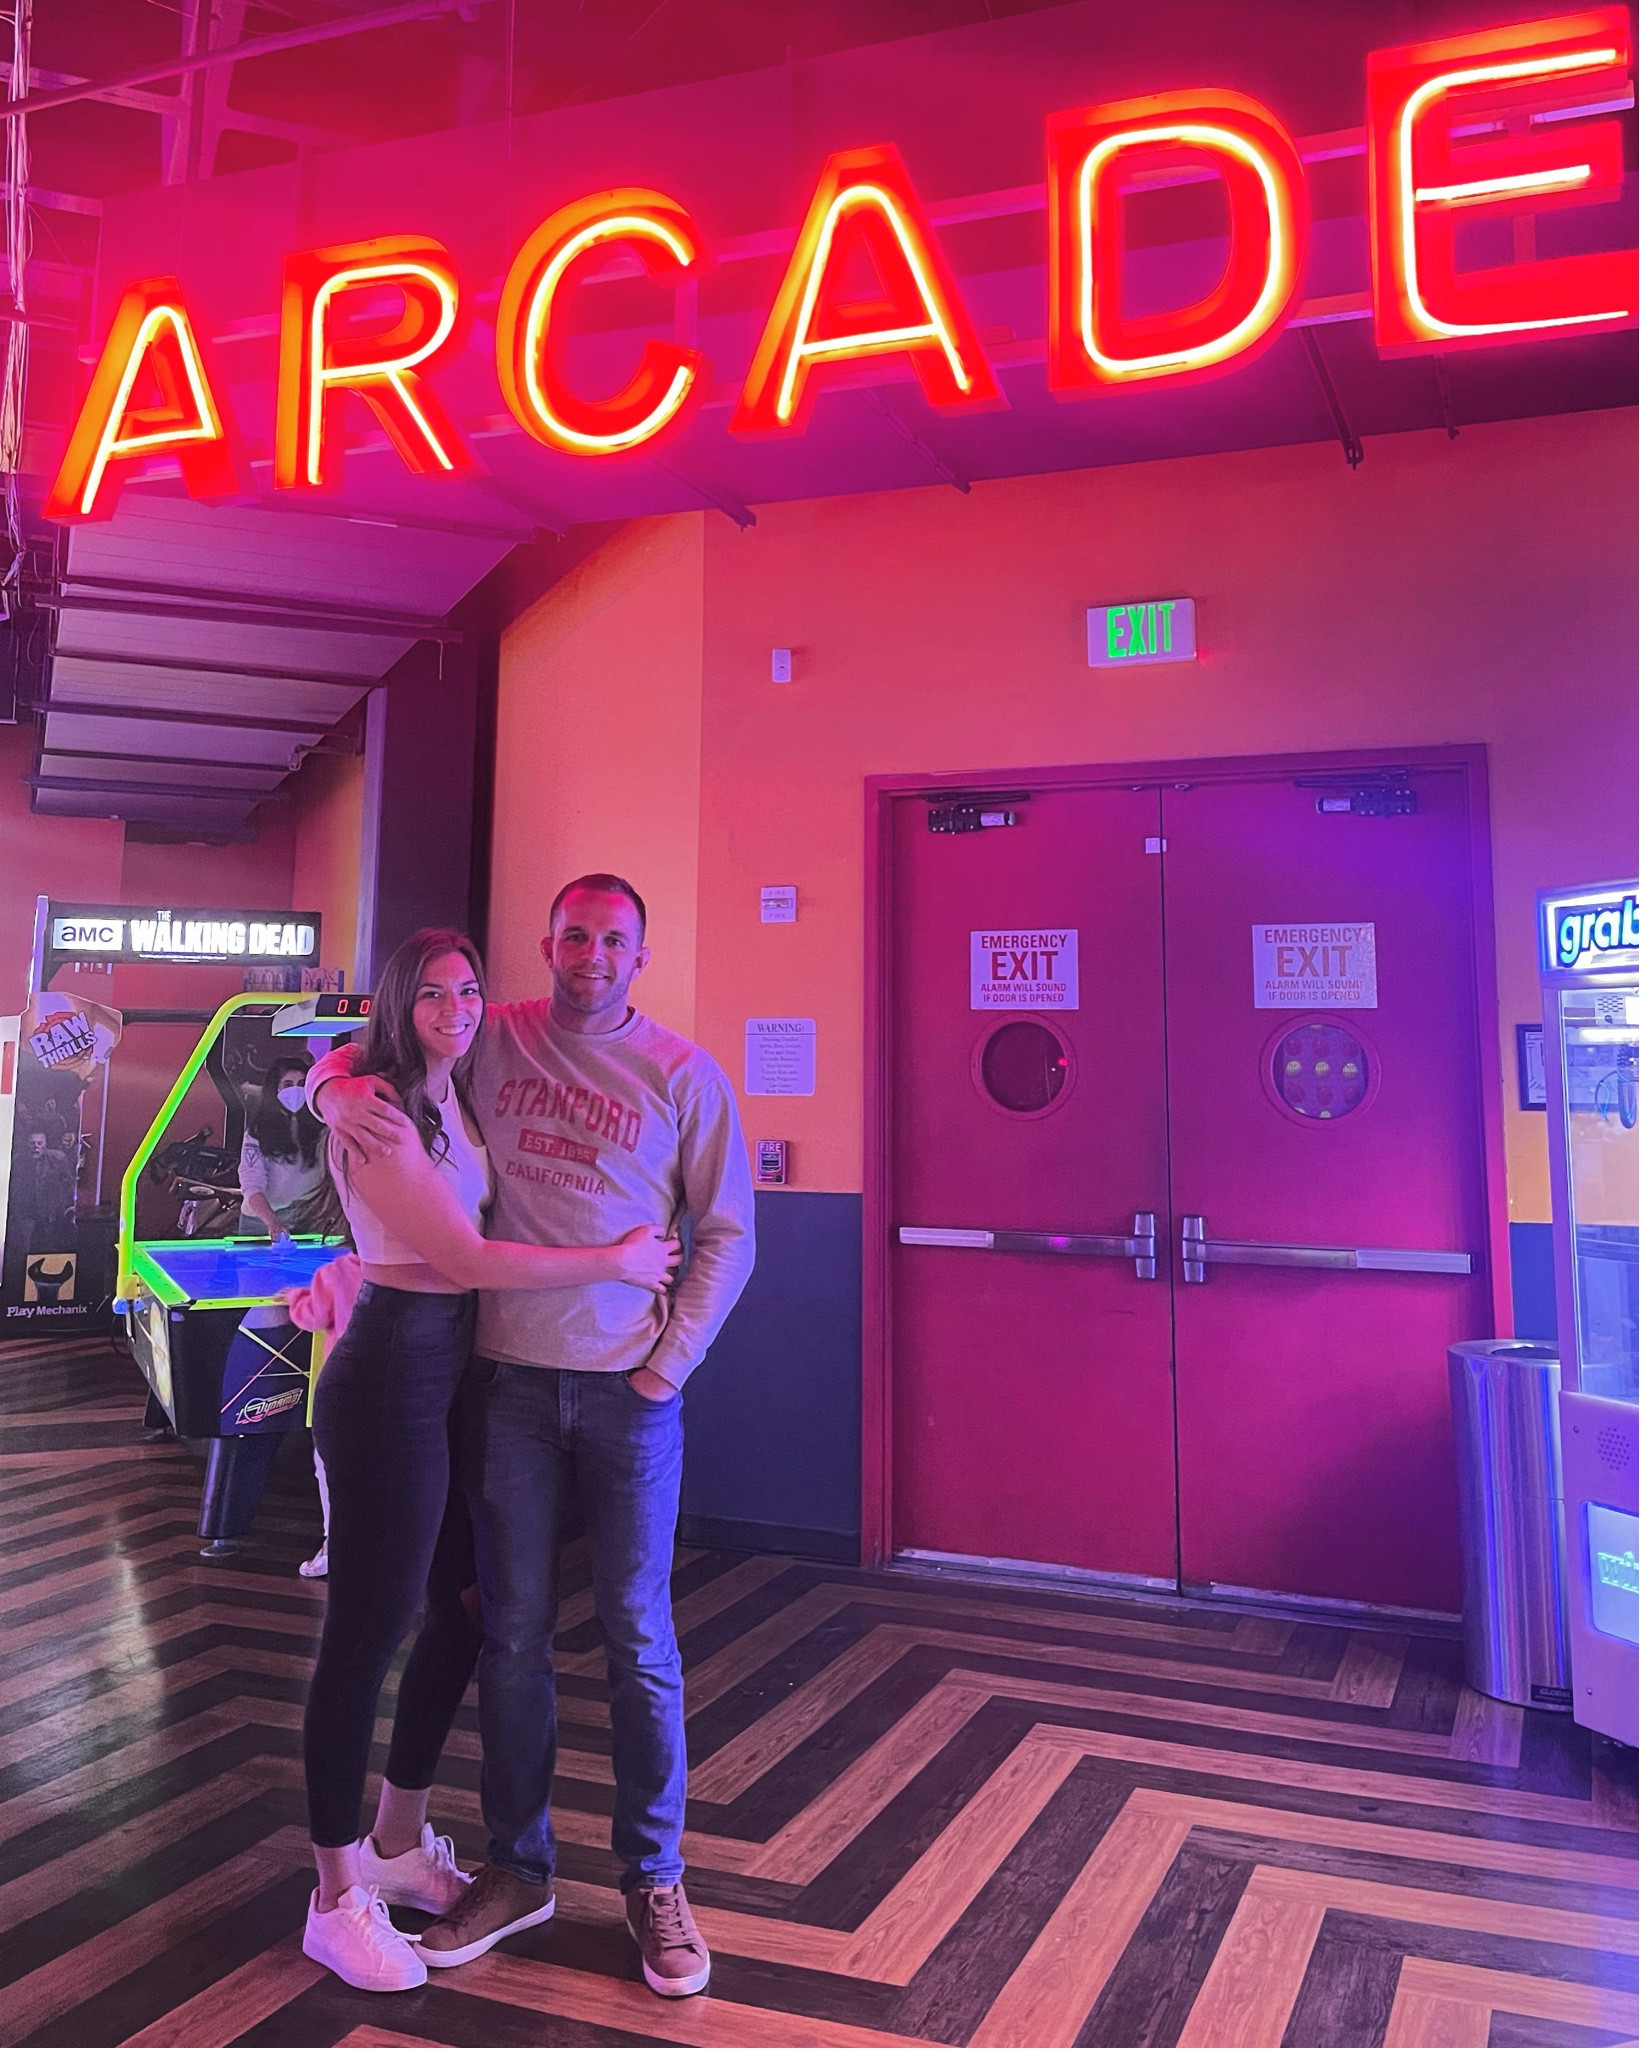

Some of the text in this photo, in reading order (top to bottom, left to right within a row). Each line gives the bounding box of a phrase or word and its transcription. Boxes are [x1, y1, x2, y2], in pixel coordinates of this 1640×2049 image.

[42, 7, 1638, 525] ARCADE
[1107, 602, 1175, 658] EXIT
[157, 910, 172, 921] THE
[130, 920, 315, 956] WALKING DEAD
[981, 934, 1067, 949] EMERGENCY
[1264, 927, 1363, 944] EMERGENCY
[991, 951, 1059, 980] EXIT
[1276, 945, 1353, 978] EXIT
[981, 983, 1067, 992] ALARM WILL SOUND
[1265, 980, 1363, 990] ALARM WILL SOUND
[983, 993, 1065, 1002] IF DOOR IS OPENED
[1268, 991, 1360, 1000] IF DOOR IS OPENED
[29, 1012, 90, 1057] RAW
[757, 1023, 805, 1033] WARNING:
[38, 1031, 98, 1069] THRILLS
[494, 1077, 642, 1153] STANFORD
[760, 1142, 782, 1152] FIRE
[504, 1160, 606, 1195] CALIFORNIA
[6, 1304, 88, 1318] Play Mechanix
